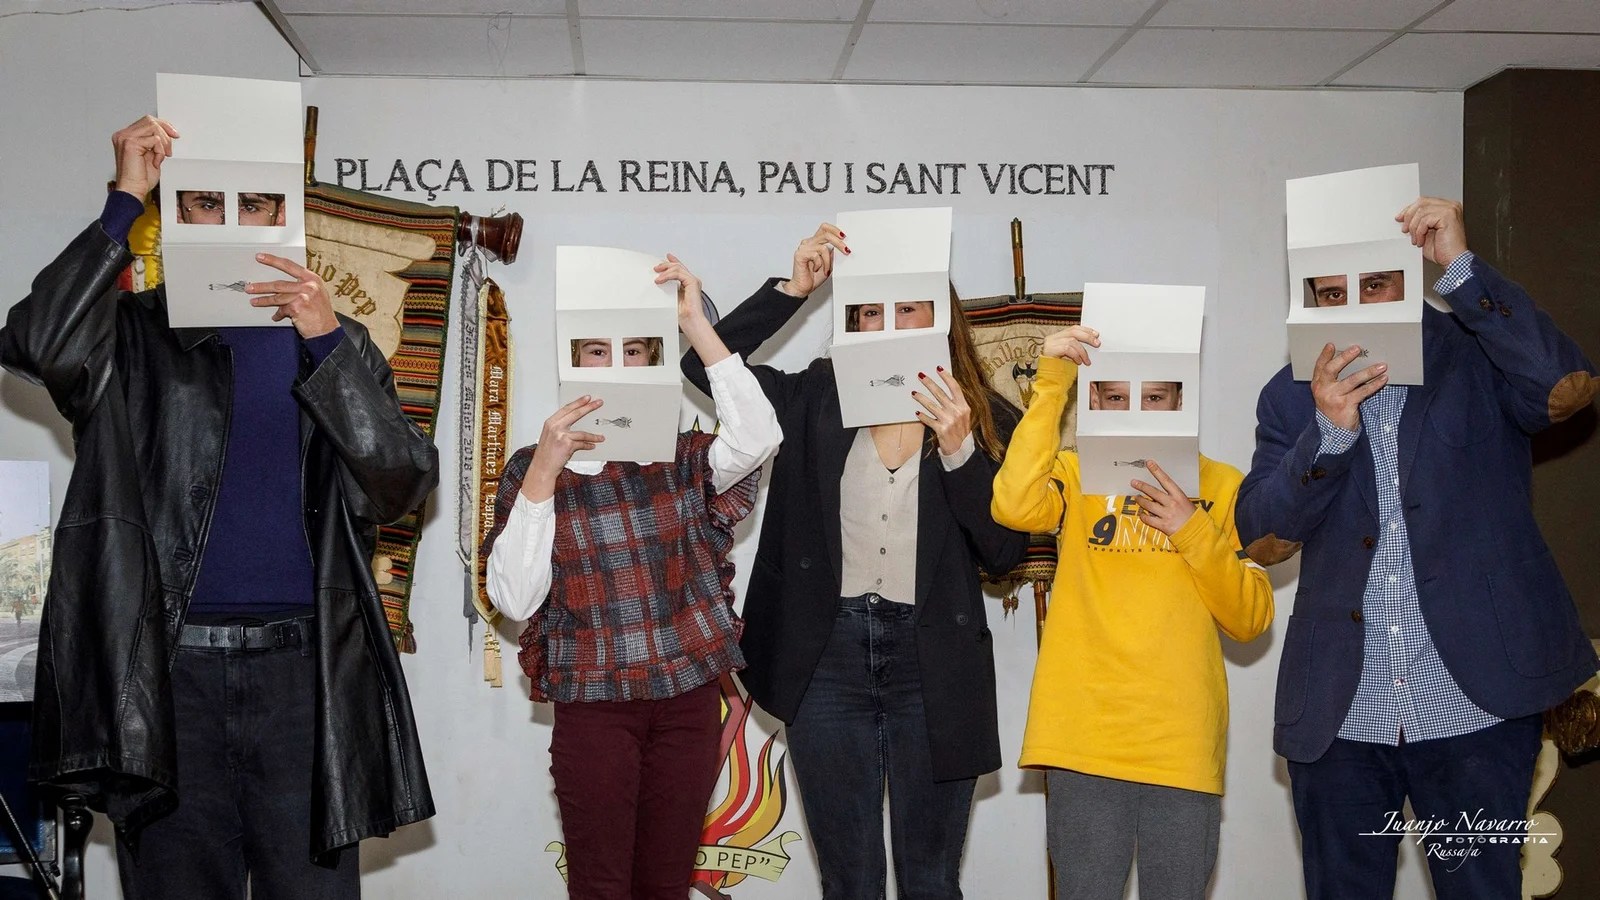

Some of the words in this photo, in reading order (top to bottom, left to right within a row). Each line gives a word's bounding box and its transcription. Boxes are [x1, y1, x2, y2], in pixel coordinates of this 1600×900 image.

[334, 158, 475, 200] PLAÇA
[486, 158, 539, 192] DE
[550, 159, 608, 193] LA
[618, 159, 746, 198] REINA,
[757, 160, 832, 194] PAU
[844, 162, 855, 194] I
[866, 162, 967, 195] SANT
[978, 163, 1115, 196] VICENT
[334, 272, 377, 317] Pep
[488, 366, 503, 403] Mara
[463, 437, 473, 471] 2018
